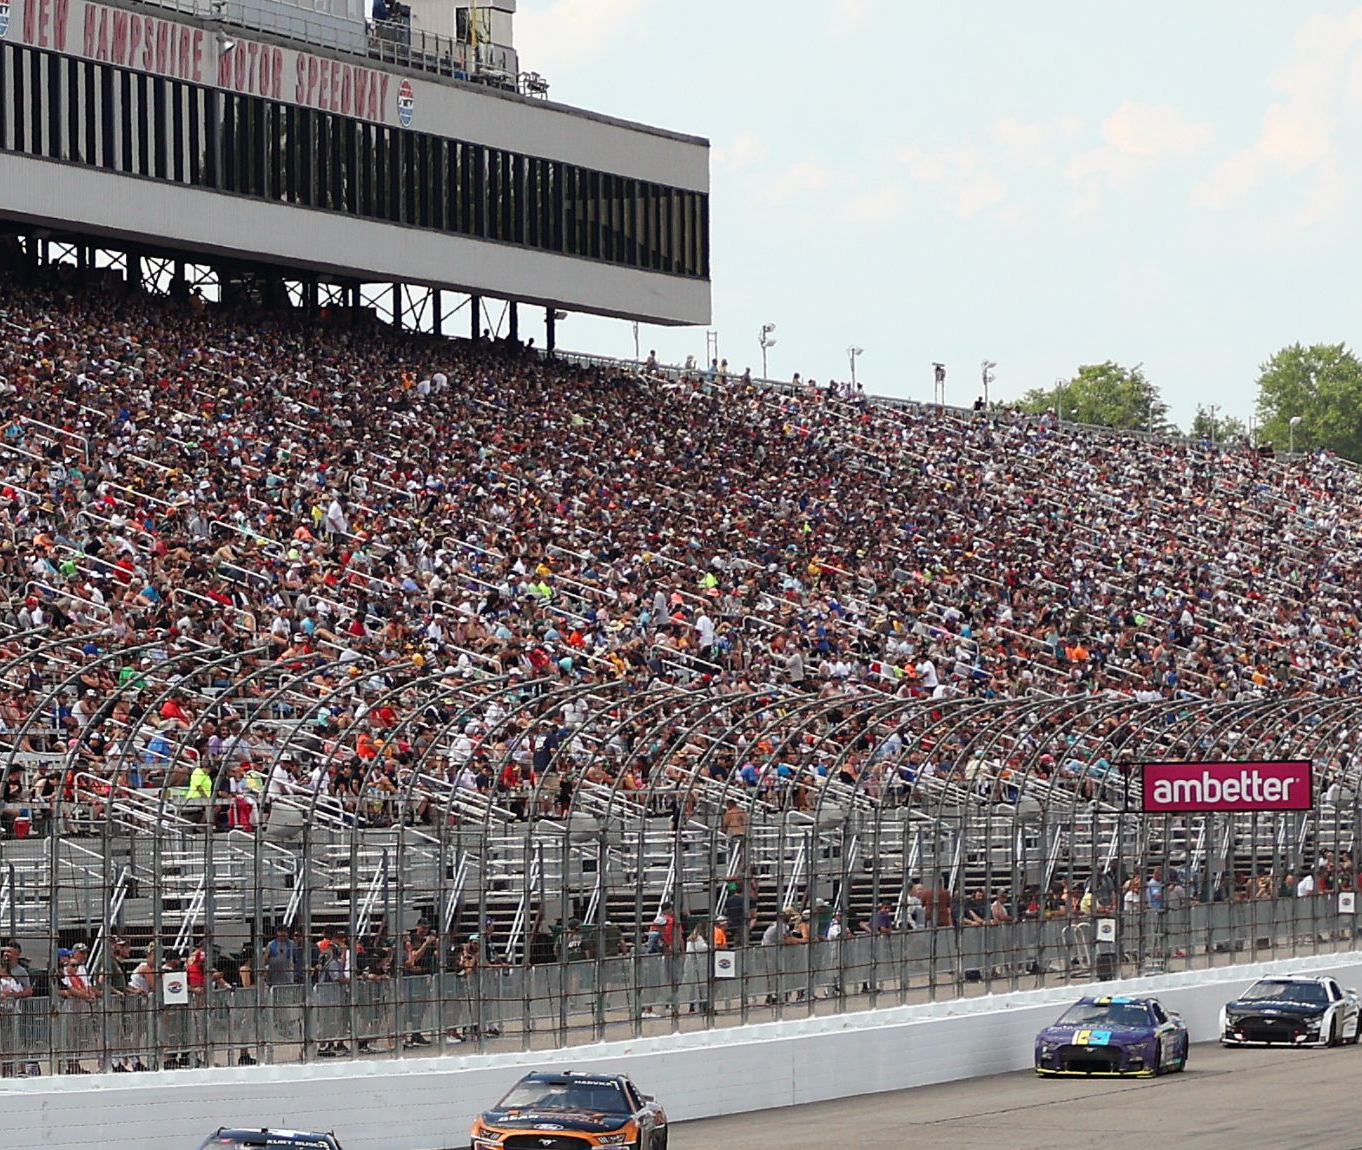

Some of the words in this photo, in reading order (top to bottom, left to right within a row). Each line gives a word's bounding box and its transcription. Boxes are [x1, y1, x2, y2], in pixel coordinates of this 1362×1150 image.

[23, 0, 69, 51] NEW
[83, 3, 205, 81] HAMPSHIRE
[218, 36, 283, 100] MOTOR
[295, 51, 390, 122] SPEEDWAY
[1153, 770, 1294, 804] ambetter
